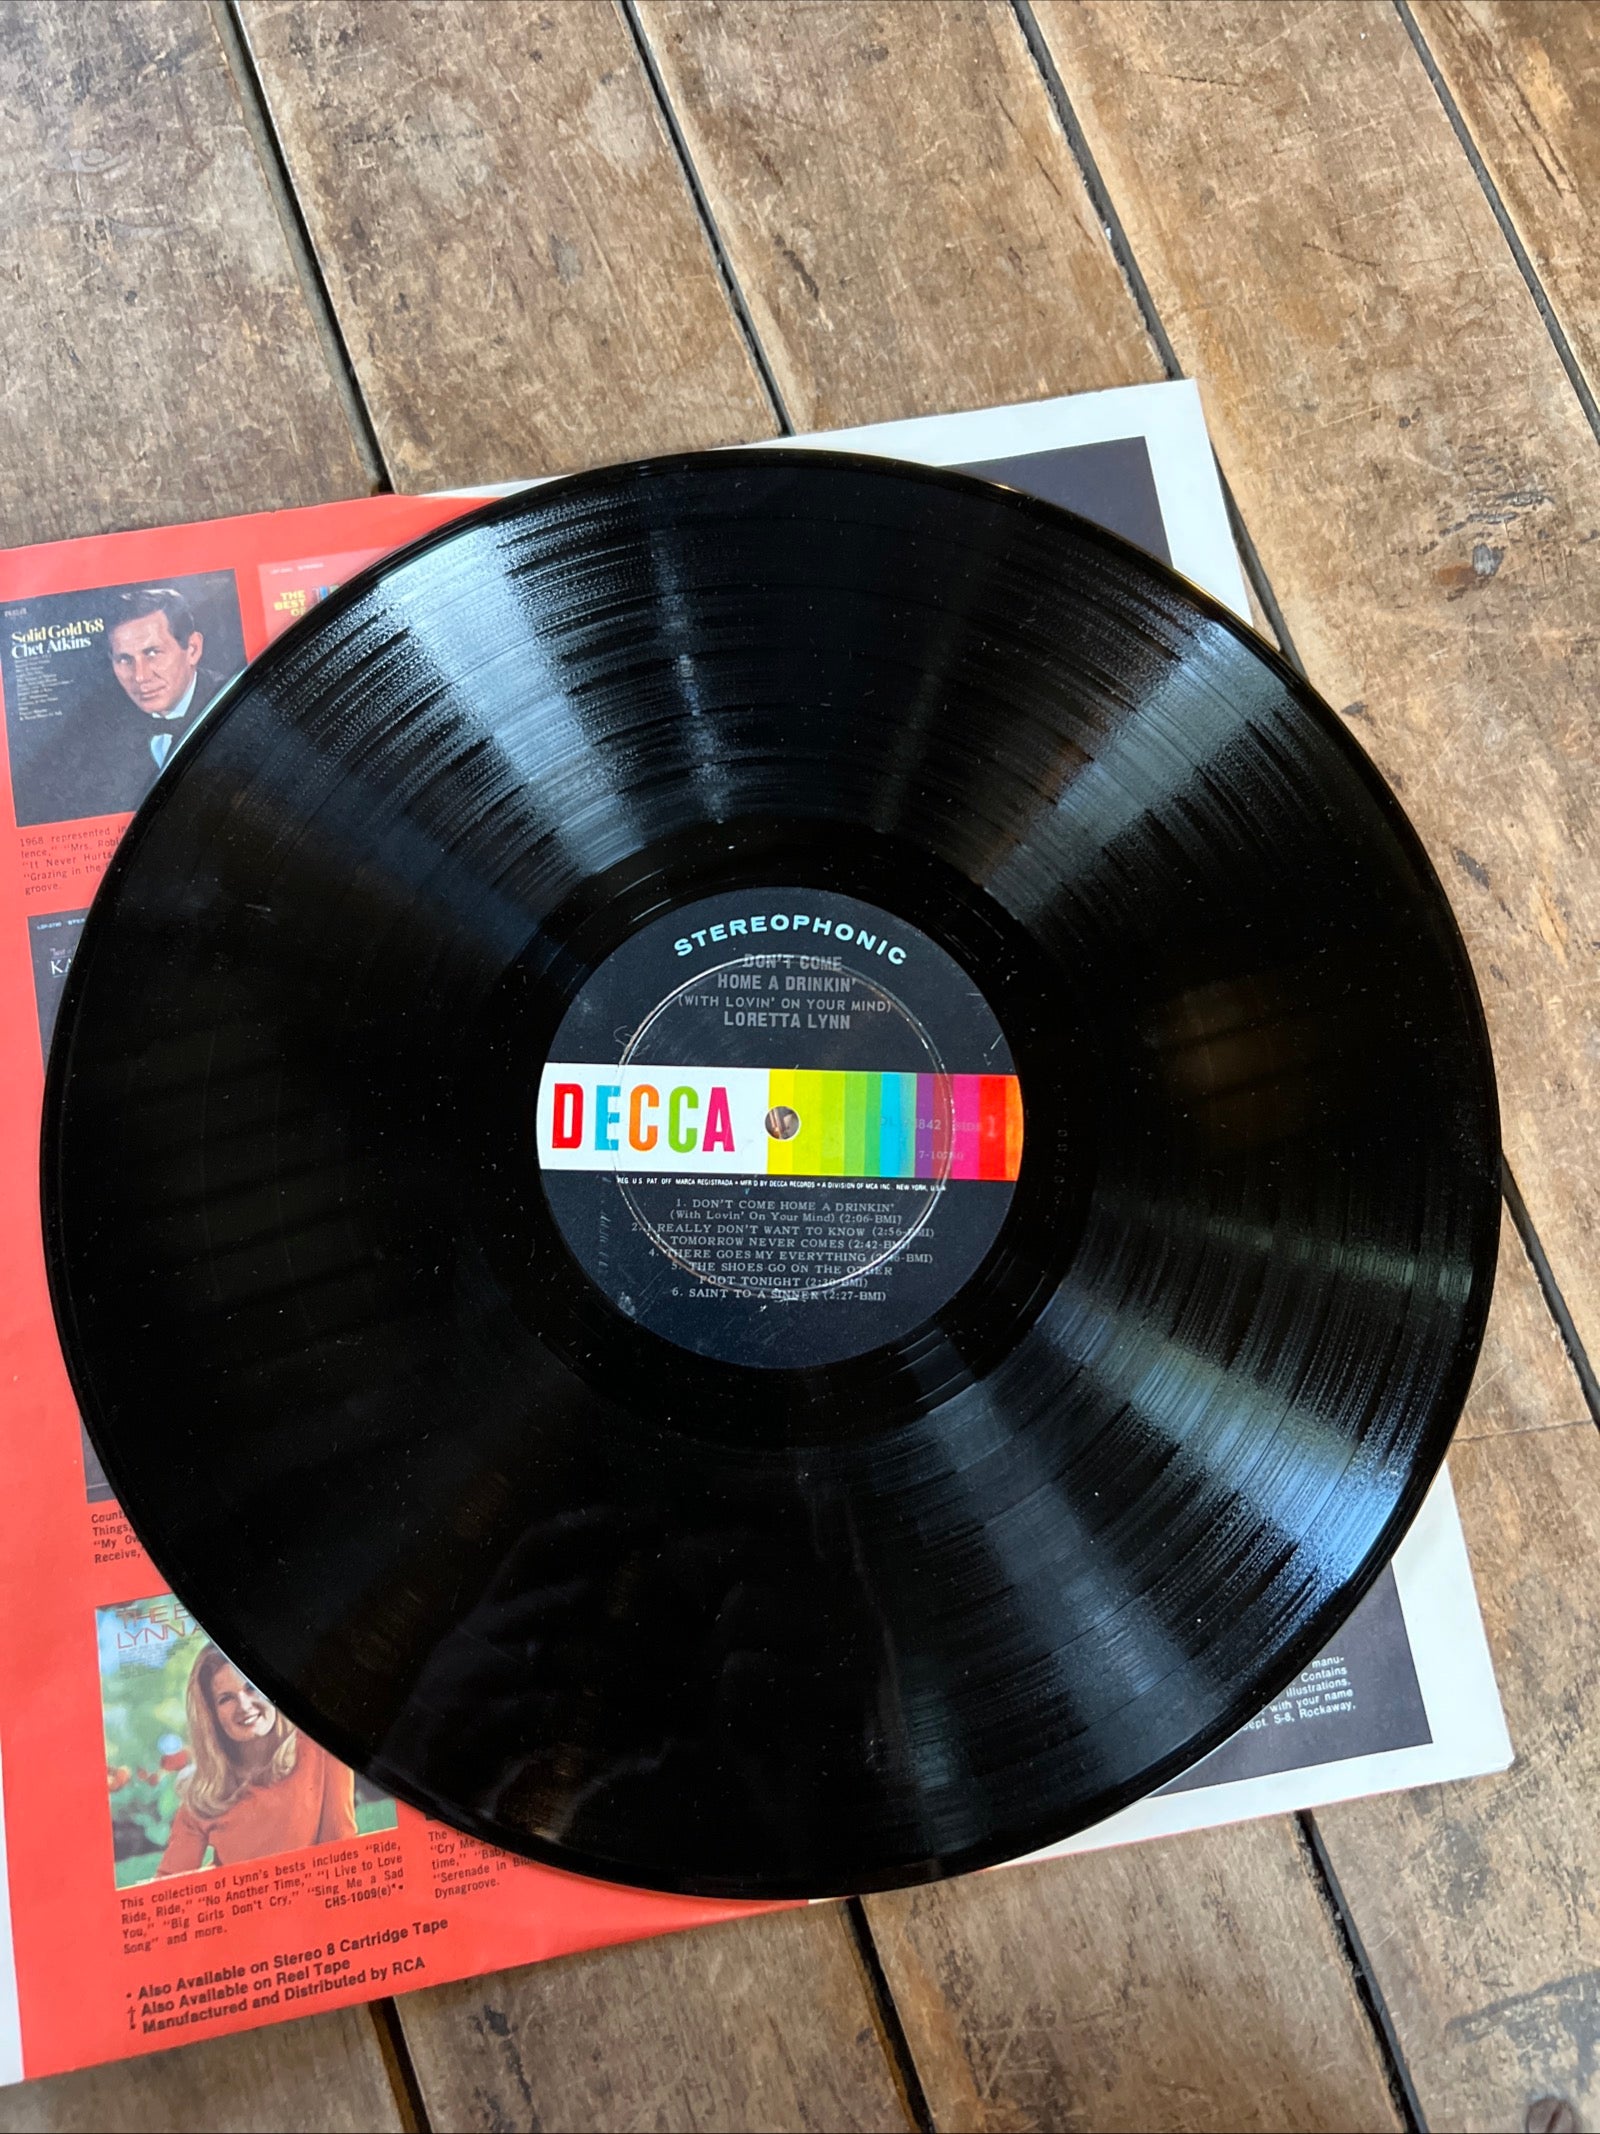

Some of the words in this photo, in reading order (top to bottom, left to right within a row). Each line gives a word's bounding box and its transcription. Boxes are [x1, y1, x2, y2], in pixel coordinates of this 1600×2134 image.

[281, 590, 305, 600] THE
[273, 599, 305, 611] BEST
[11, 626, 46, 643] Solid
[48, 621, 82, 638] Gold
[11, 642, 43, 659] Chet
[47, 636, 91, 653] Atkins
[20, 837, 44, 847] 1968
[51, 827, 110, 843] represented
[46, 857, 77, 867] Never
[71, 867, 81, 876] in
[86, 863, 101, 873] the
[25, 883, 62, 896] groove.
[674, 914, 907, 965] STEREOPHONIC
[744, 953, 794, 969] DON'T
[800, 955, 842, 972] COME
[717, 973, 762, 990] HOME
[768, 975, 779, 990] A
[785, 975, 856, 993] DRINKIN'
[678, 995, 719, 1007] (WITH
[726, 997, 775, 1008] LOVIN'
[781, 998, 800, 1009] ON
[806, 999, 845, 1011] YOUR
[851, 1001, 892, 1013] MIND)
[724, 1011, 800, 1028] LORETTA
[807, 1014, 850, 1030] LYNN
[552, 1083, 735, 1153] DECCA
[697, 1178, 733, 1186] REGISTRADA
[760, 1179, 768, 1187] BY
[769, 1179, 788, 1188] DECCA
[789, 1180, 815, 1188] RECORDS
[821, 1180, 827, 1188] A
[827, 1181, 855, 1189] DIVISION
[856, 1181, 864, 1189] OF
[865, 1181, 878, 1190] MCA
[896, 1183, 910, 1191] NEW
[676, 1198, 687, 1207] 1.
[692, 1199, 734, 1209] DON'T
[738, 1200, 775, 1209] COME
[780, 1201, 816, 1211] HOME
[822, 1203, 831, 1211] A
[835, 1203, 895, 1212] DRINKIN'
[670, 1210, 701, 1220] (With
[706, 1210, 744, 1220] Lovin'
[749, 1211, 766, 1220] On
[771, 1212, 798, 1222] Your
[802, 1213, 835, 1223] Mind)
[656, 1223, 712, 1233] REALLY
[717, 1224, 759, 1234] DON'T
[764, 1225, 800, 1235] WANT
[805, 1226, 823, 1235] TO
[828, 1227, 865, 1237] KNOW
[670, 1235, 745, 1246] TOMORROW
[749, 1237, 795, 1248] NEVER
[800, 1239, 845, 1249] COMES
[648, 1249, 659, 1257] 4.
[716, 1250, 750, 1259] GOES
[754, 1251, 774, 1260] MY
[779, 1252, 866, 1262] EVERYTHING
[689, 1262, 716, 1272] THE
[721, 1263, 764, 1272] SHOES
[768, 1264, 786, 1273] GO
[791, 1264, 809, 1273] ON
[814, 1265, 842, 1274] THE
[700, 1275, 735, 1286] FOOT
[740, 1276, 801, 1287] TONIGHT
[671, 1287, 683, 1296] 6.
[688, 1288, 728, 1298] SAINT
[733, 1289, 752, 1298] TO
[757, 1289, 766, 1298] A
[770, 1289, 819, 1300] SINNER
[824, 1290, 887, 1301] (2:27-BMI)
[116, 1604, 169, 1630] THE
[117, 1620, 185, 1649] LYNN
[1312, 1656, 1345, 1669] manu-
[1301, 1666, 1348, 1682] Contains
[1270, 1700, 1292, 1713] with
[1296, 1695, 1320, 1709] your
[1324, 1688, 1354, 1702] name
[1299, 1701, 1356, 1719] Rockaway,
[428, 1830, 448, 1841] The
[460, 1839, 475, 1849] Me
[496, 1861, 507, 1871] in
[121, 1897, 144, 1910] This
[151, 1883, 208, 1904] collection
[214, 1877, 226, 1890] of
[232, 1869, 269, 1886] Lynn's
[275, 1861, 306, 1876] bests
[312, 1850, 359, 1867] includes
[434, 1878, 500, 1899] Dynagroove.
[121, 1911, 151, 1925] Ride,
[226, 1883, 270, 1903] Another
[335, 1865, 357, 1878] Live
[362, 1860, 373, 1872] to
[378, 1854, 403, 1868] Love
[197, 1909, 225, 1923] Girls
[232, 1900, 263, 1916] Don't
[346, 1878, 363, 1889] Me
[370, 1874, 376, 1884] a
[384, 1868, 404, 1881] Sad
[167, 1931, 188, 1945] and
[195, 1924, 228, 1939] more.
[138, 1984, 172, 2000] Also
[176, 1965, 246, 1992] Available
[250, 1960, 269, 1974] on
[274, 1948, 322, 1969] Stereo
[326, 1942, 335, 1956] 8
[340, 1928, 409, 1952] Cartridge
[412, 1918, 449, 1935] Tape
[141, 2001, 175, 2017] Also
[179, 1982, 248, 2009] Available
[253, 1977, 272, 1991] on
[277, 1967, 310, 1986] Reel
[314, 1958, 351, 1976] Tape
[143, 2000, 248, 2034] Manufactured
[252, 1991, 279, 2009] and
[284, 1970, 366, 2001] Distributed
[371, 1966, 388, 1982] by
[392, 1956, 426, 1976] RCA
